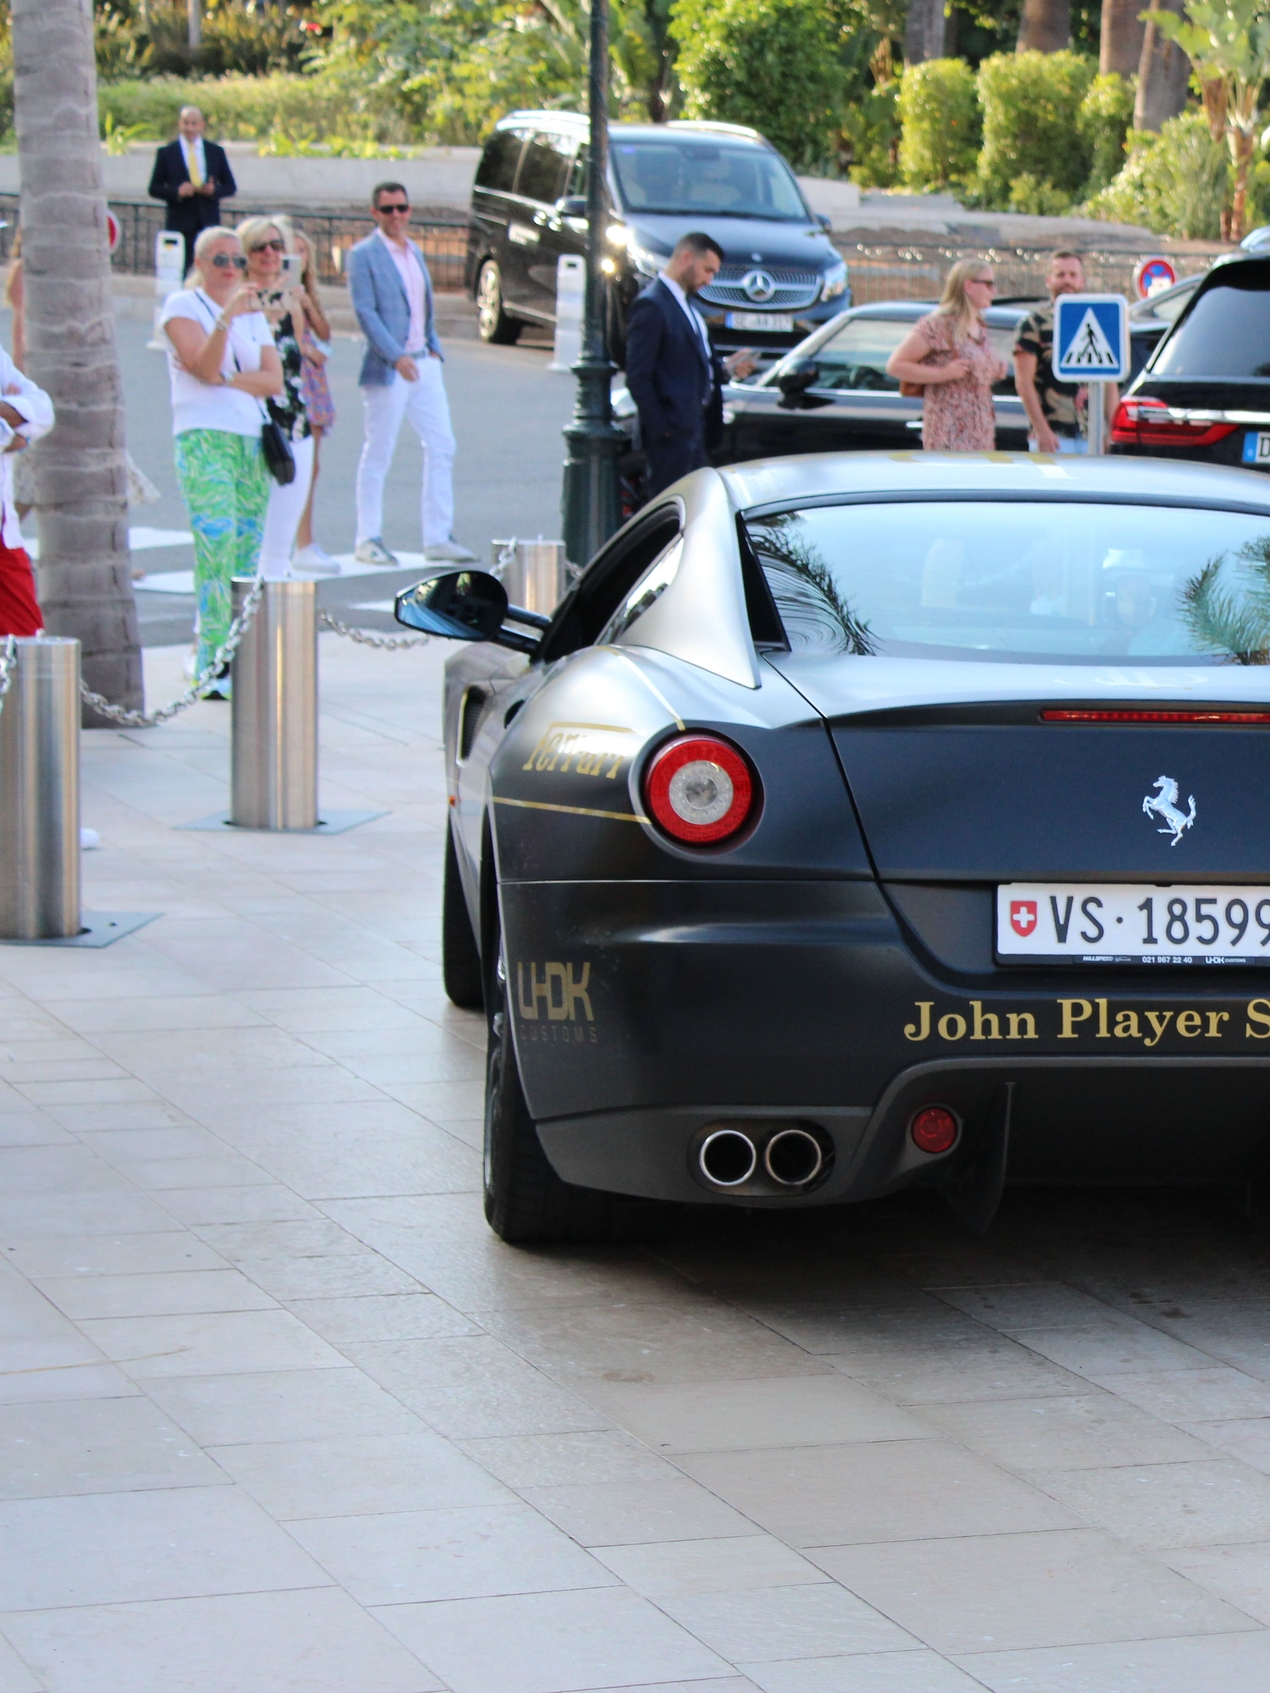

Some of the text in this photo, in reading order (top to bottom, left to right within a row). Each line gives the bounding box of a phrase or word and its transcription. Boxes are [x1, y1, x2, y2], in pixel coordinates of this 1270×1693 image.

[1157, 956, 1170, 964] 967
[1172, 956, 1182, 964] 22
[1183, 956, 1193, 964] 40
[904, 1001, 1038, 1041] John
[1056, 998, 1230, 1046] Player
[520, 1024, 598, 1043] CUSTOMS
